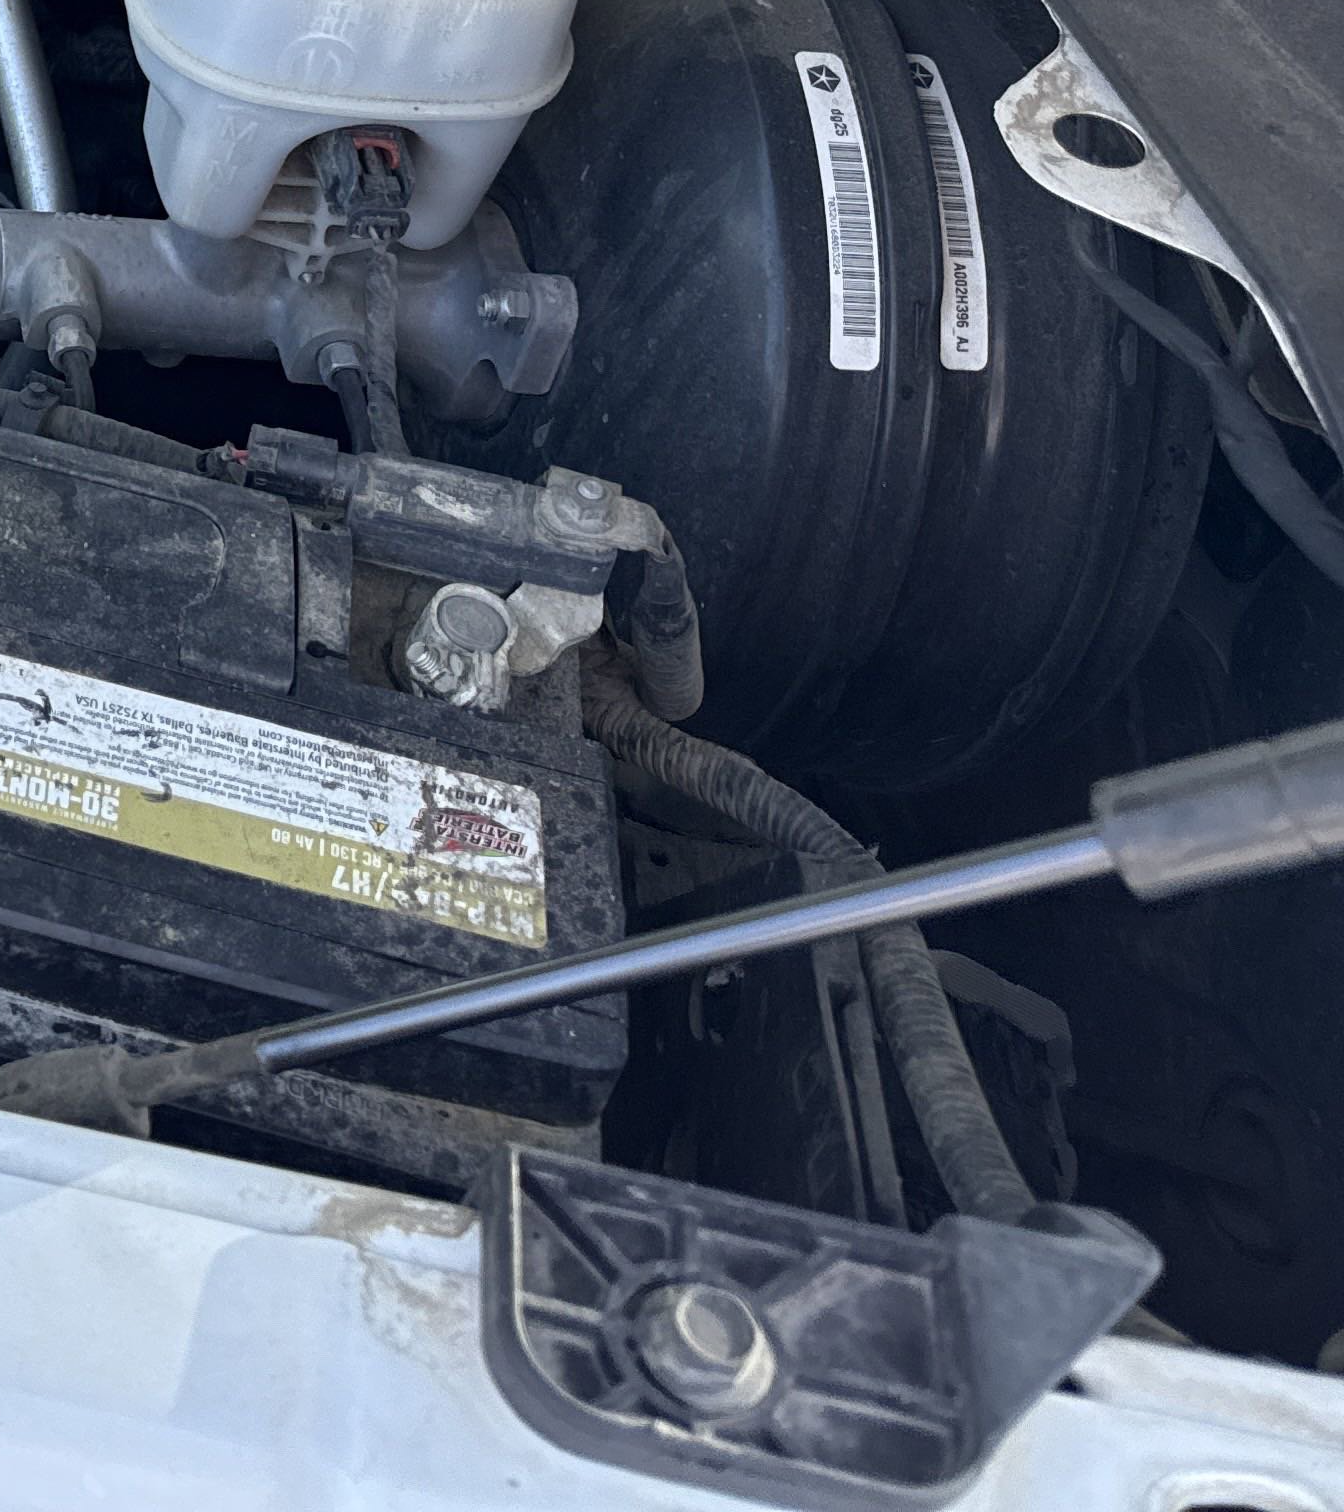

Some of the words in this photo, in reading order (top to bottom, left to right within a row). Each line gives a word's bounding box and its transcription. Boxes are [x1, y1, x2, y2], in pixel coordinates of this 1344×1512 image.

[830, 108, 848, 136] dg25
[74, 692, 98, 708] USA
[101, 699, 138, 719] 75251
[140, 709, 153, 723] TX
[155, 713, 193, 733] Dallas,
[251, 738, 304, 762] Interstate
[307, 752, 321, 767] by
[324, 757, 388, 784] Distributed
[84, 778, 121, 798] FREE
[270, 825, 290, 845] 80
[420, 810, 521, 843] BATTERIE
[294, 832, 314, 851] Ah
[413, 820, 527, 857] INTERSTAE
[329, 841, 358, 863] 130
[362, 849, 381, 869] RC
